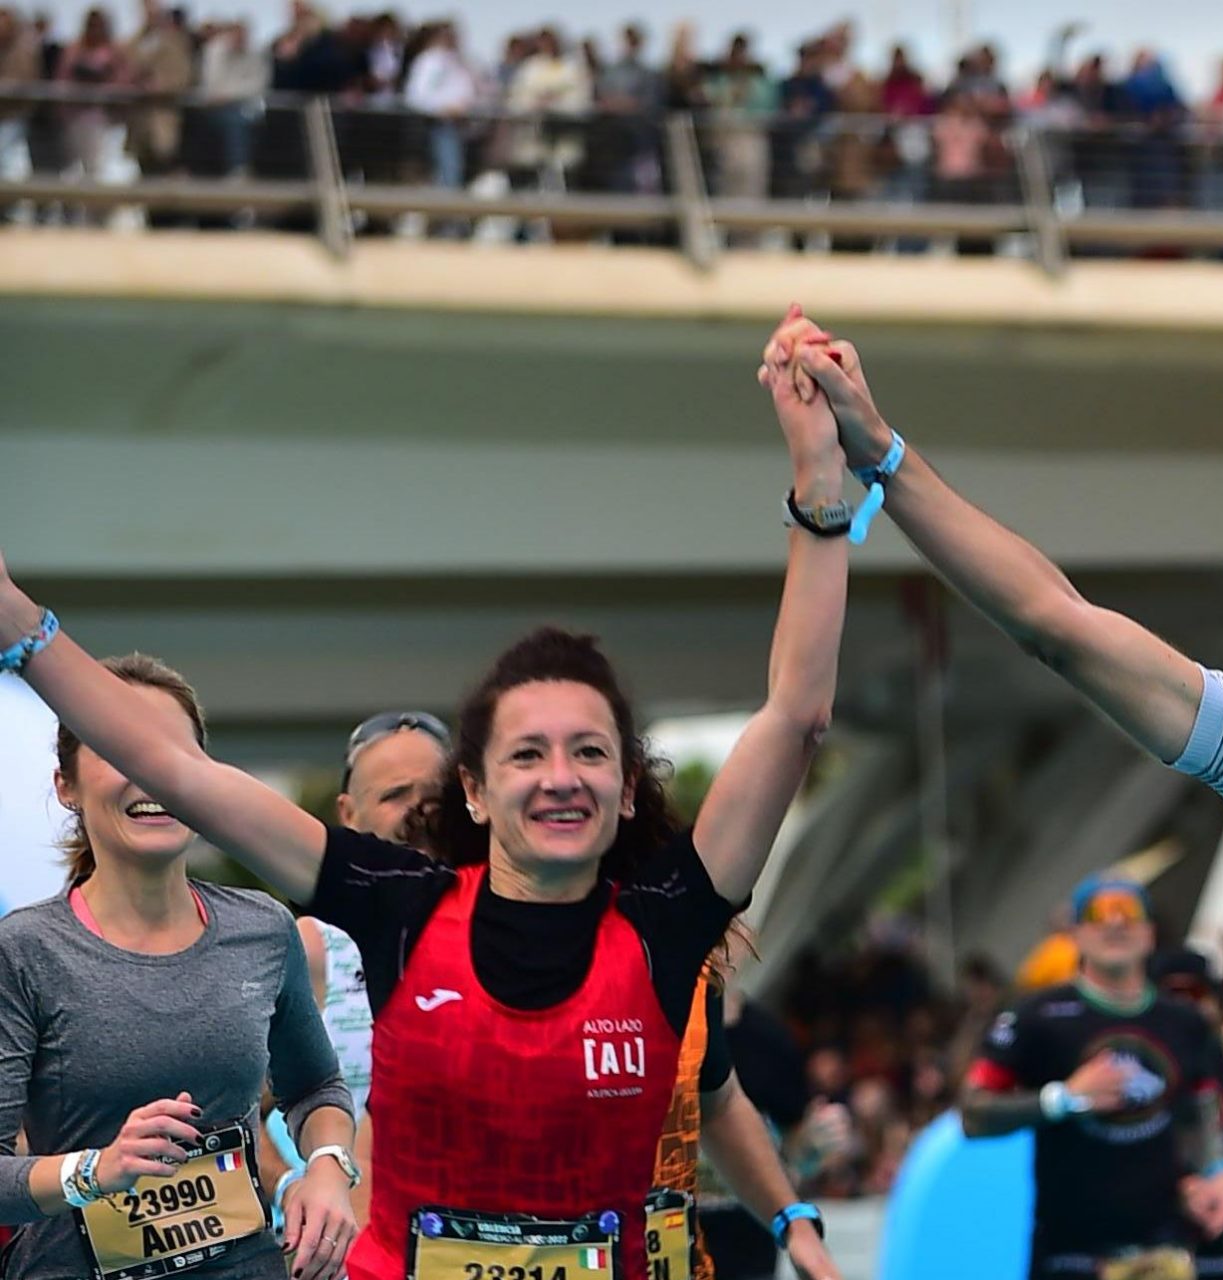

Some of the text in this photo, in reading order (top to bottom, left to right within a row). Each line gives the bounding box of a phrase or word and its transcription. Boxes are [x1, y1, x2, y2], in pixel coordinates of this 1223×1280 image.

[582, 1018, 614, 1034] ALTO
[123, 1174, 216, 1223] 23990
[142, 1214, 224, 1258] Anne
